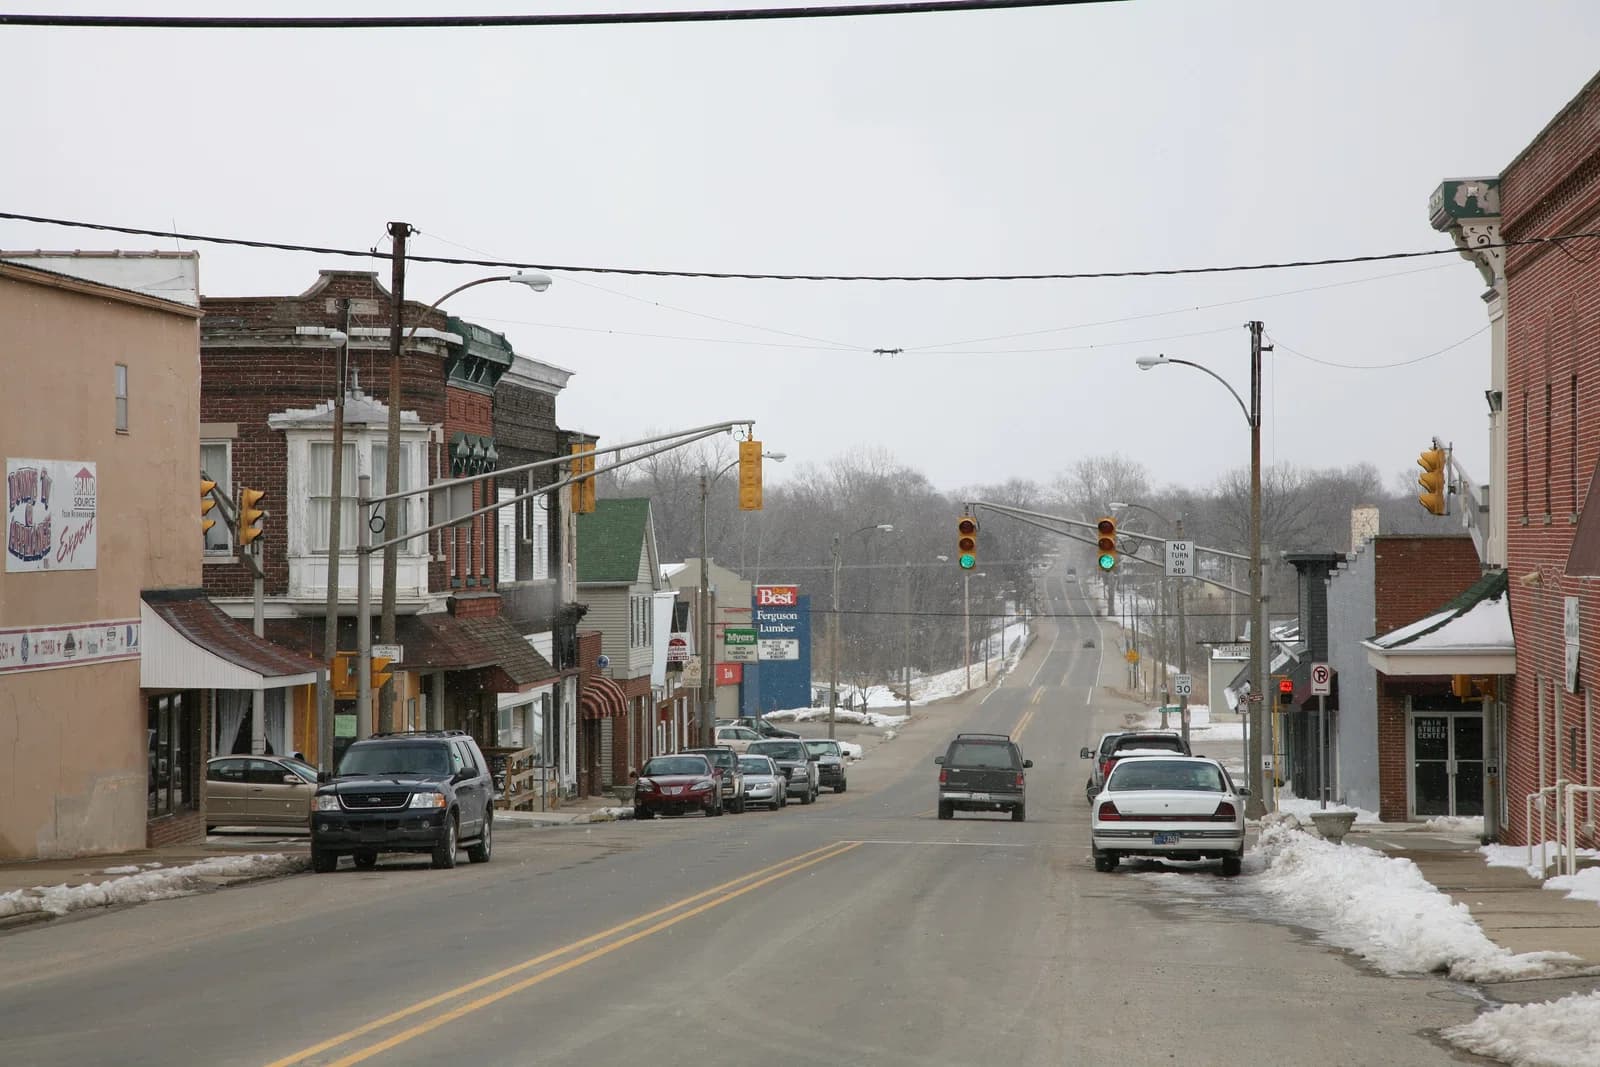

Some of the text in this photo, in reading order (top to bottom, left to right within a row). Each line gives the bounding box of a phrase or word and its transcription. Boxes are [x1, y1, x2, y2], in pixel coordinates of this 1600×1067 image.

[74, 477, 95, 496] BRAND
[74, 497, 95, 507] SOURCE
[1173, 543, 1186, 551] NO
[1171, 551, 1189, 559] TURN
[759, 589, 793, 604] Best
[757, 610, 797, 623] Ferguson
[760, 623, 795, 633] Lumber
[727, 633, 754, 643] Myers
[1176, 685, 1191, 694] 30
